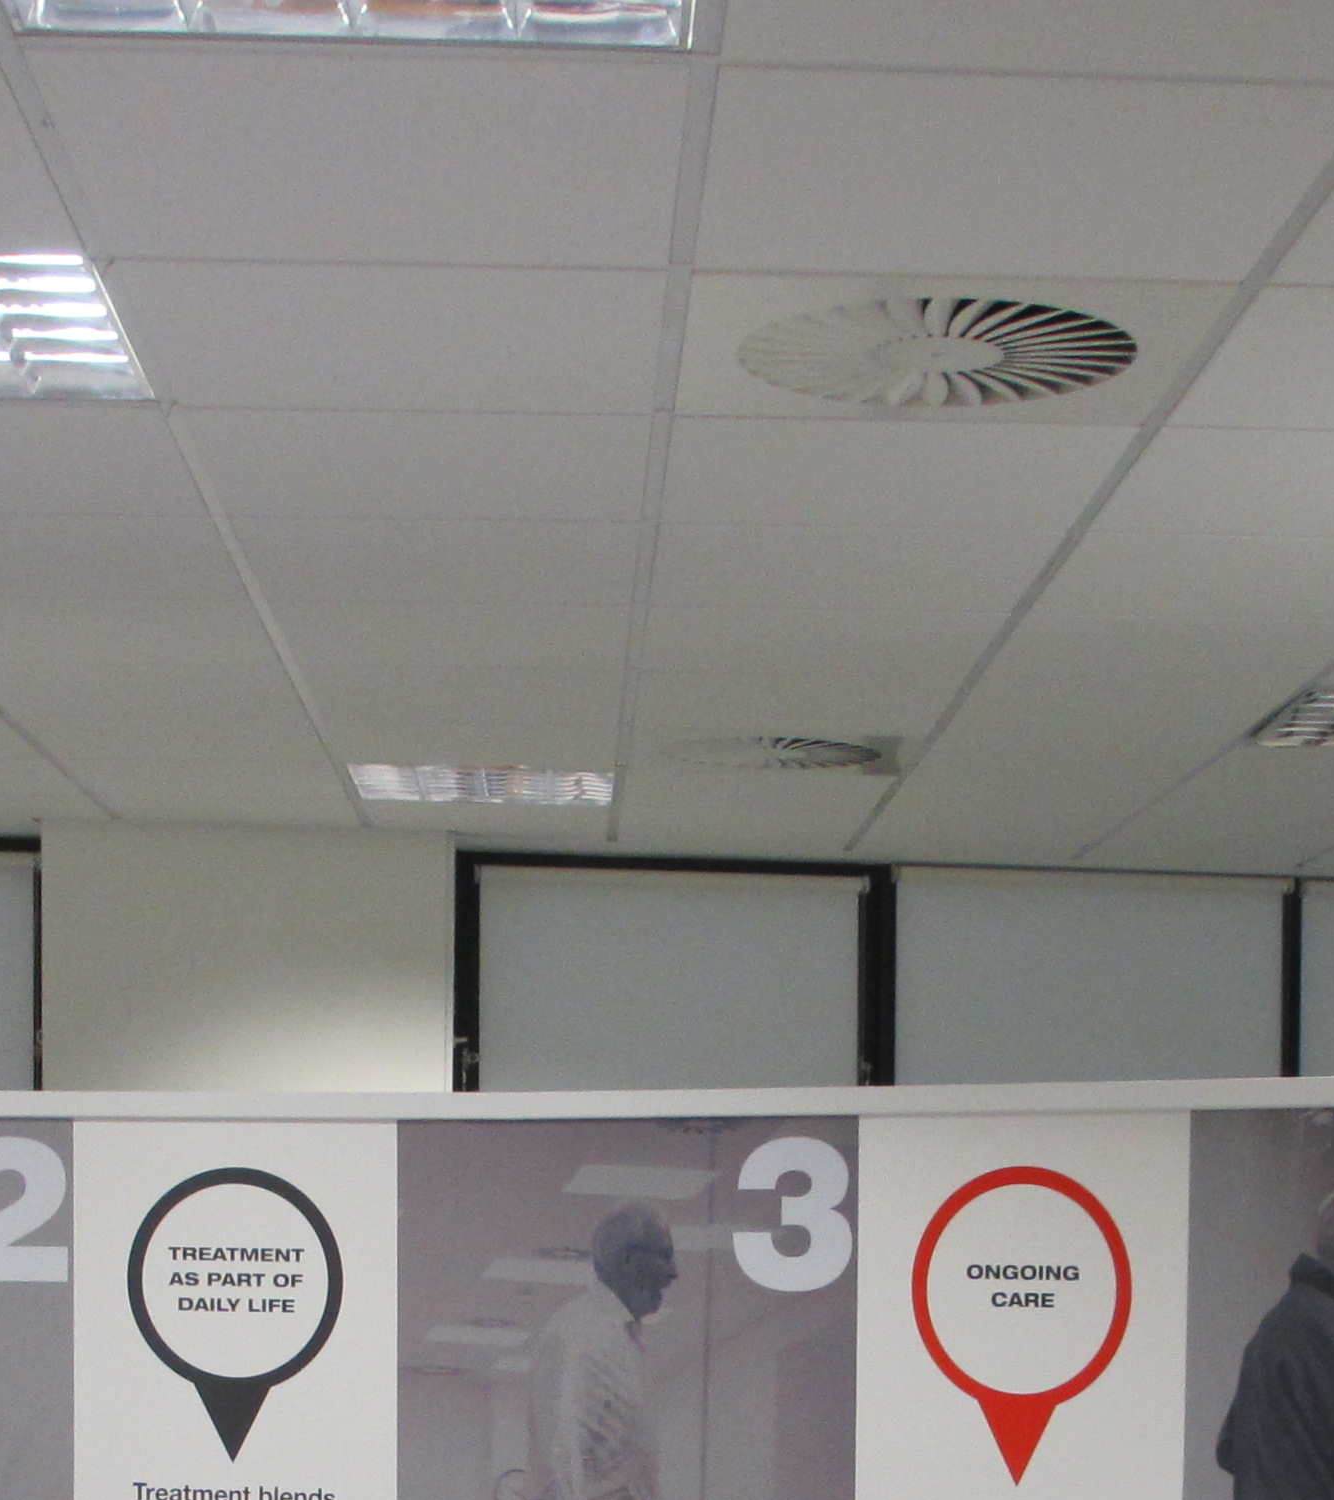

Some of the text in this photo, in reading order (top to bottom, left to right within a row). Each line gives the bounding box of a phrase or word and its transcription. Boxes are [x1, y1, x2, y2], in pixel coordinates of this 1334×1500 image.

[732, 1137, 852, 1292] 3
[169, 1247, 304, 1262] TREATMENT
[170, 1272, 302, 1287] AS PART OF
[967, 1264, 1079, 1281] ONGOING
[178, 1297, 294, 1313] DAILY LIFE
[991, 1292, 1054, 1308] CARE
